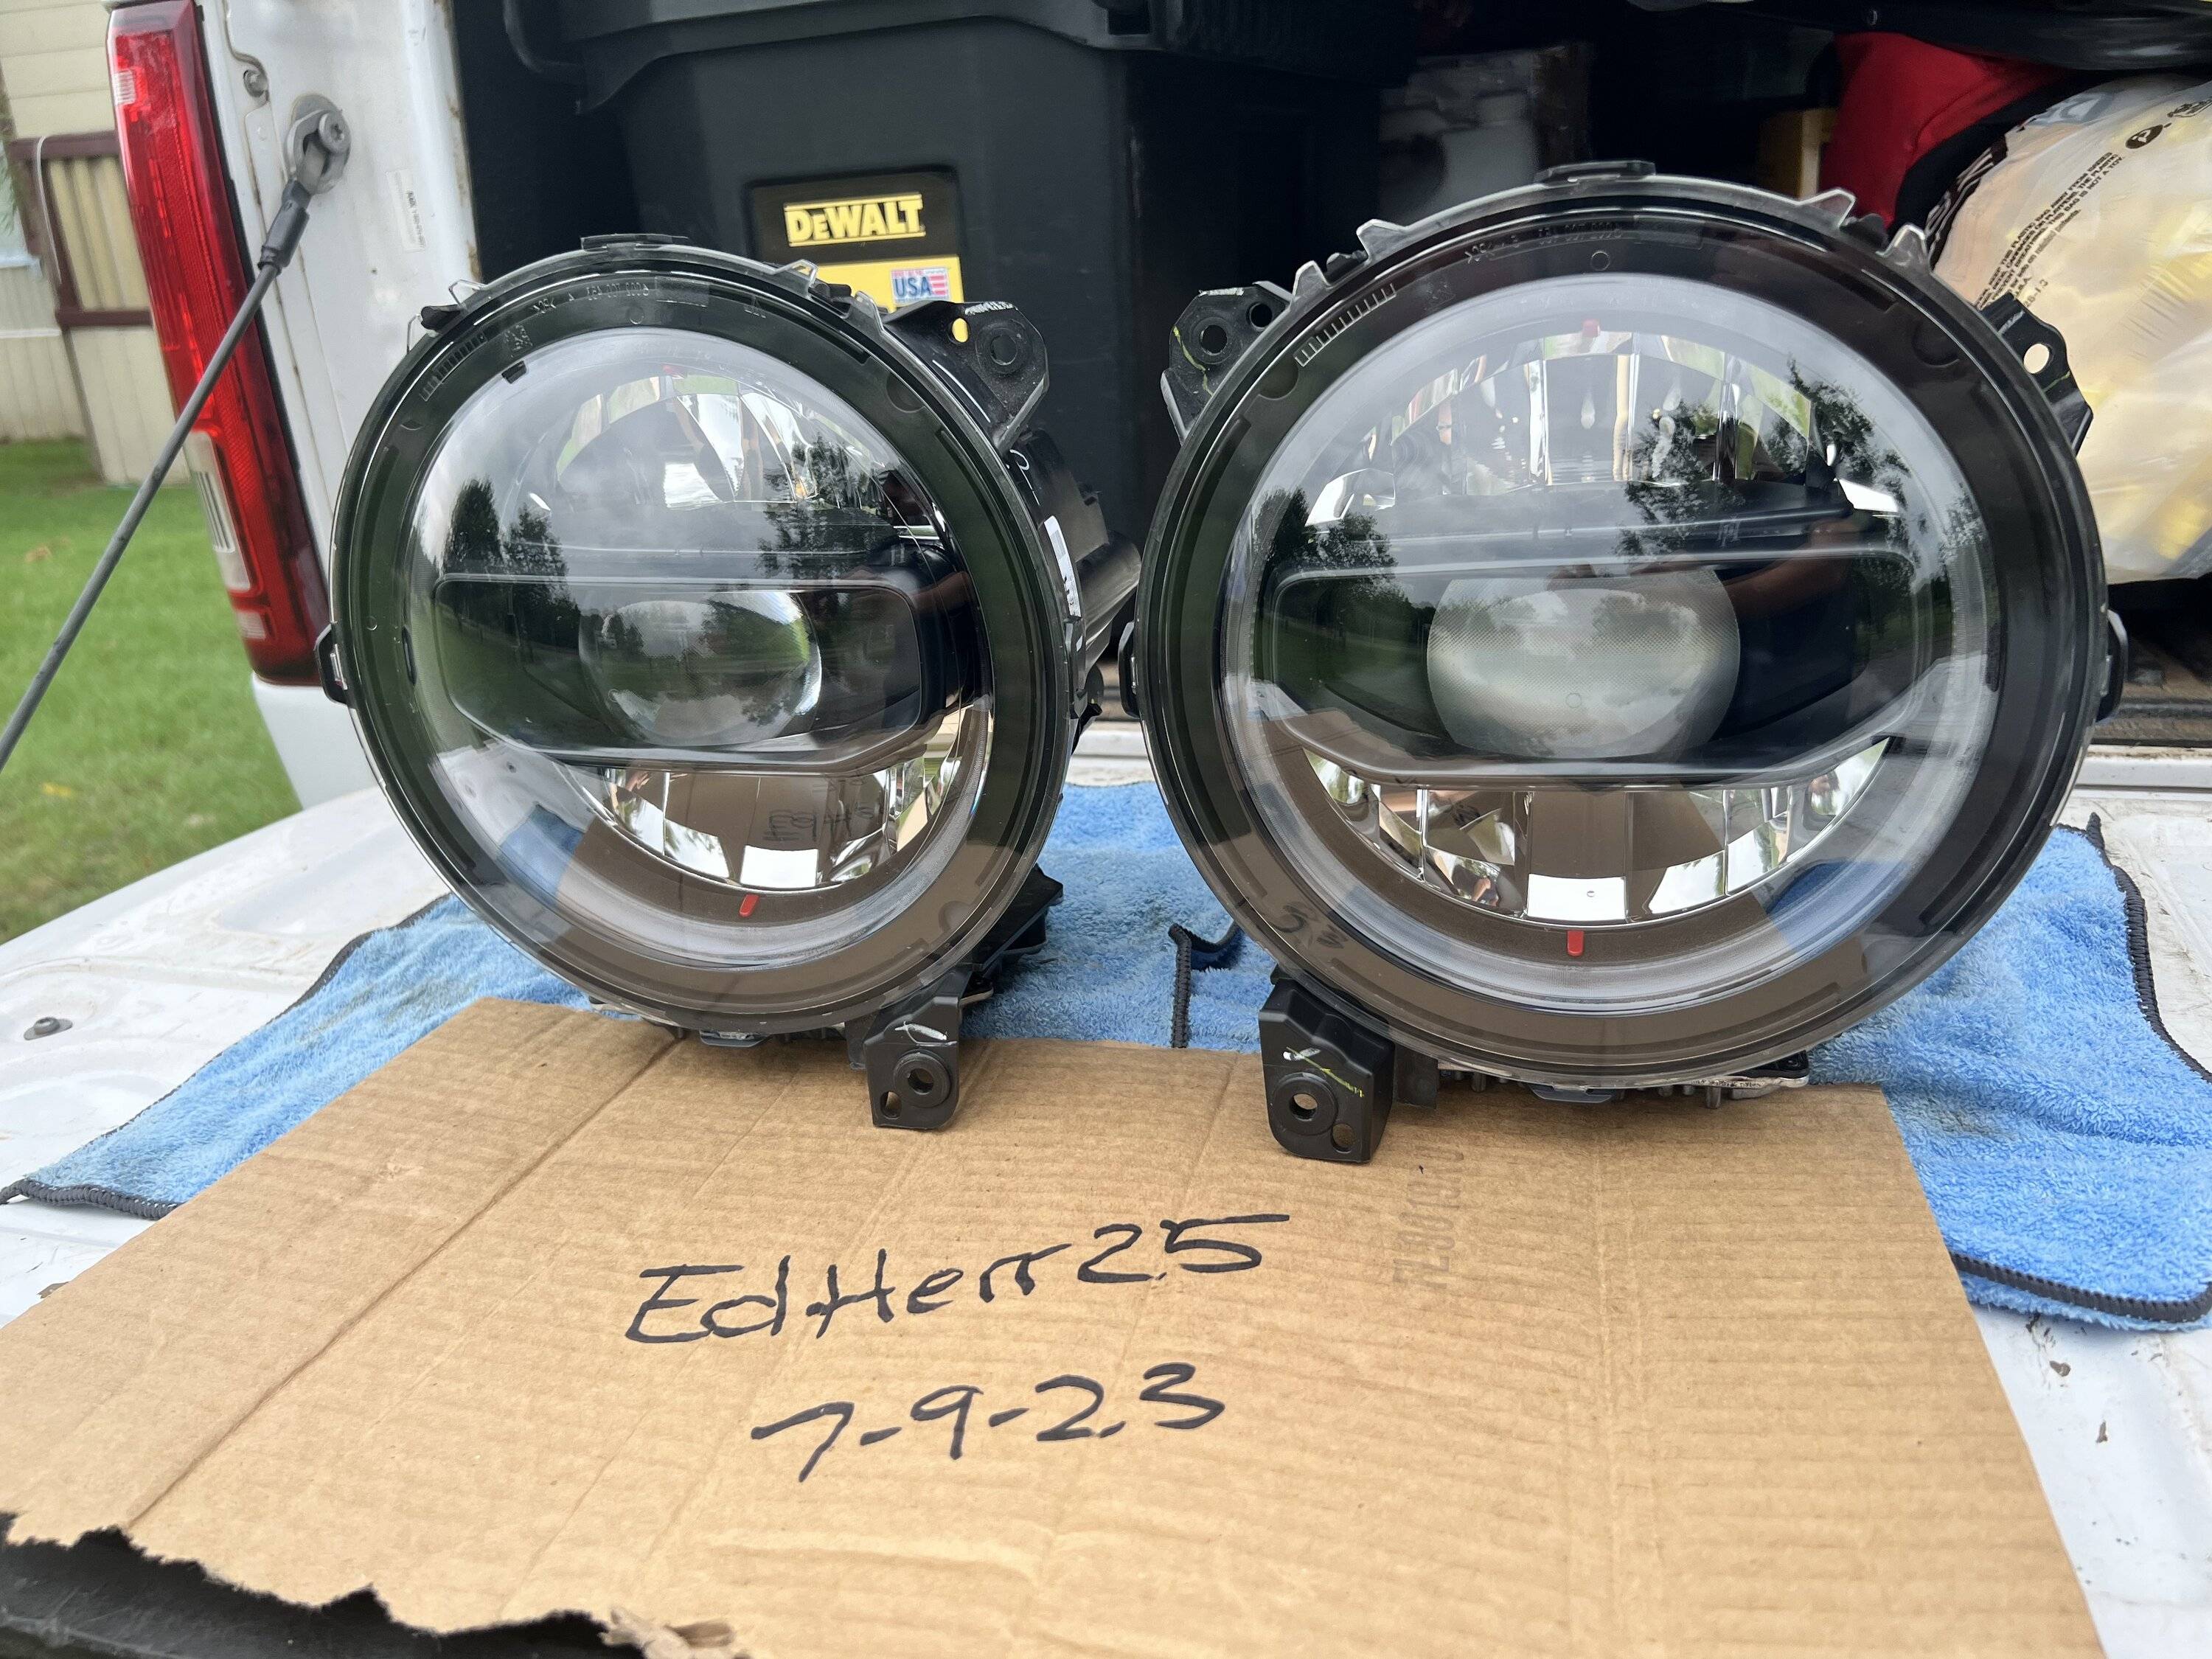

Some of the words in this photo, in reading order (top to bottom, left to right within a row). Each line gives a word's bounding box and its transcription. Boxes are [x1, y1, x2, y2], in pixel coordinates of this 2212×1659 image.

[2087, 175, 2101, 190] NOT
[2010, 220, 2035, 248] PLASTIC
[894, 276, 933, 296] USA
[751, 1362, 1225, 1482] 7-9-23
